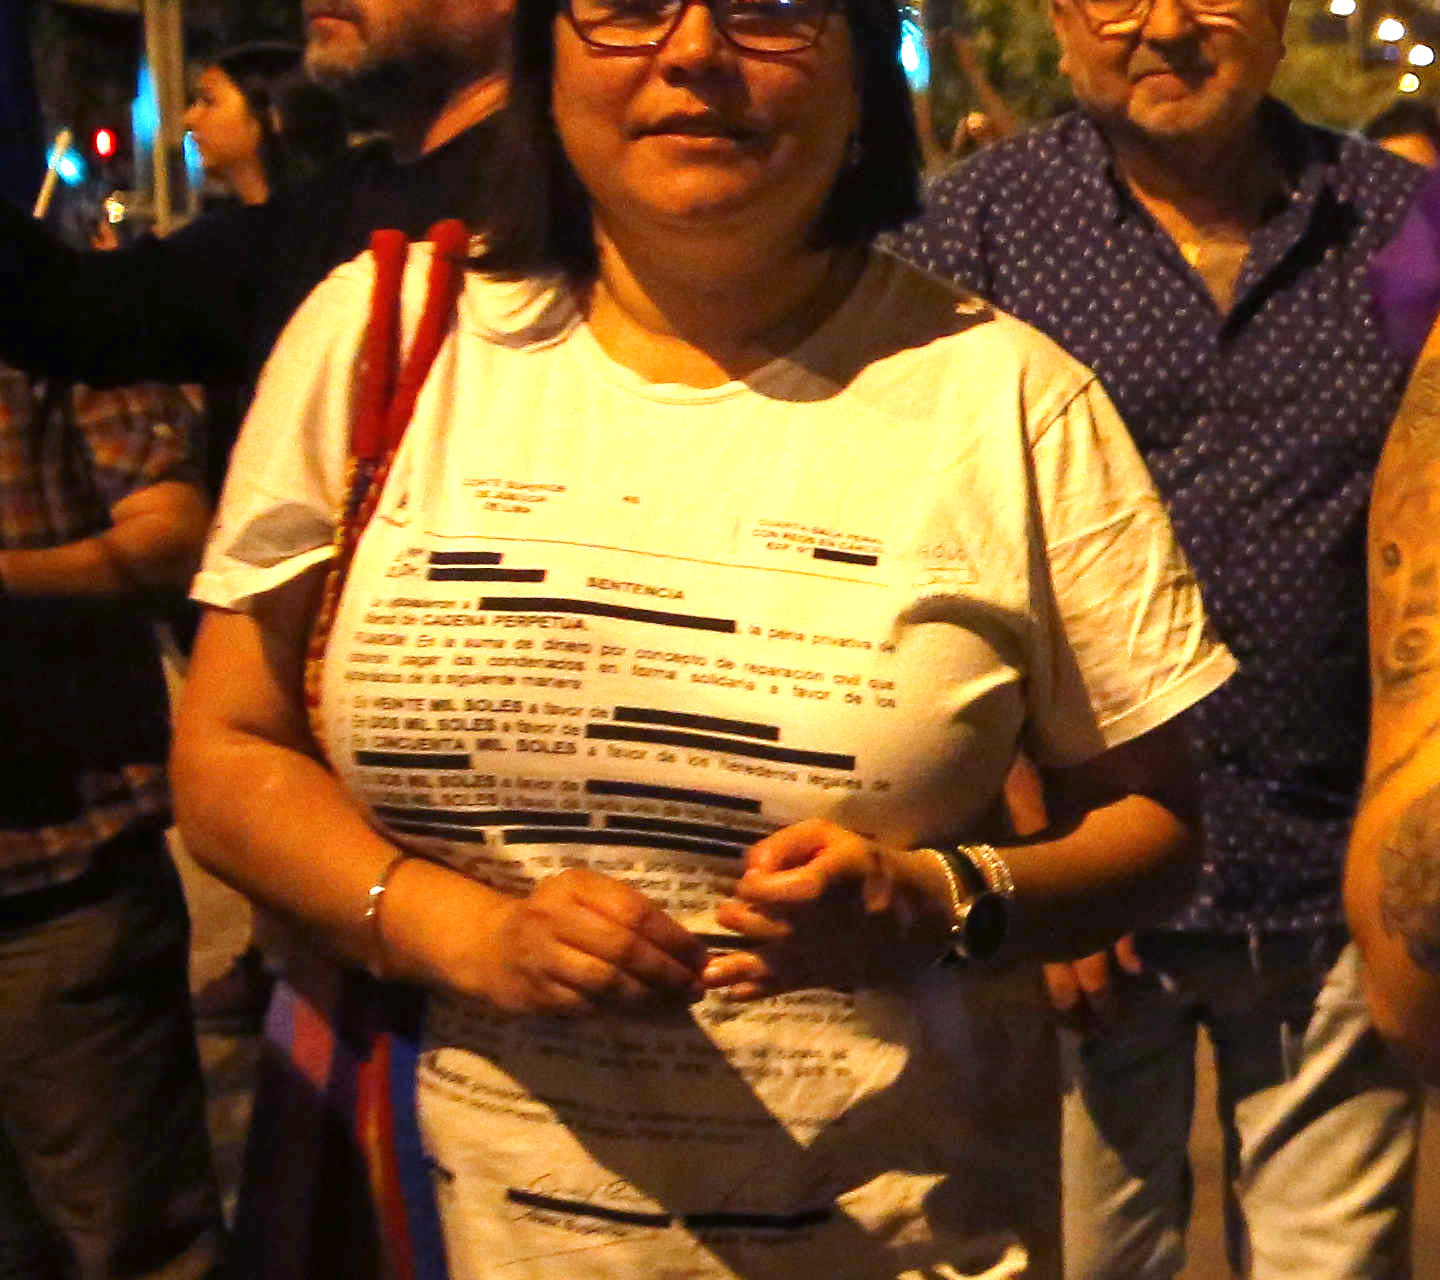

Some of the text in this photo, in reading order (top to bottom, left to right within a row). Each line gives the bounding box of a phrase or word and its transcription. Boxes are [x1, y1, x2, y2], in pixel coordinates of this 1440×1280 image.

[586, 577, 684, 600] SENTENCIA
[422, 614, 487, 627] CADENA
[768, 628, 806, 642] pena
[600, 645, 627, 657] por
[634, 649, 708, 666] concepto
[715, 656, 736, 670] de
[868, 678, 896, 692] que
[487, 657, 586, 672] condenados
[632, 664, 678, 680] forma
[792, 684, 831, 700] favor
[844, 691, 862, 705] de
[464, 697, 524, 713] SOLES
[437, 716, 497, 732] SOLES
[516, 738, 578, 754] SOLES
[607, 743, 648, 760] favor
